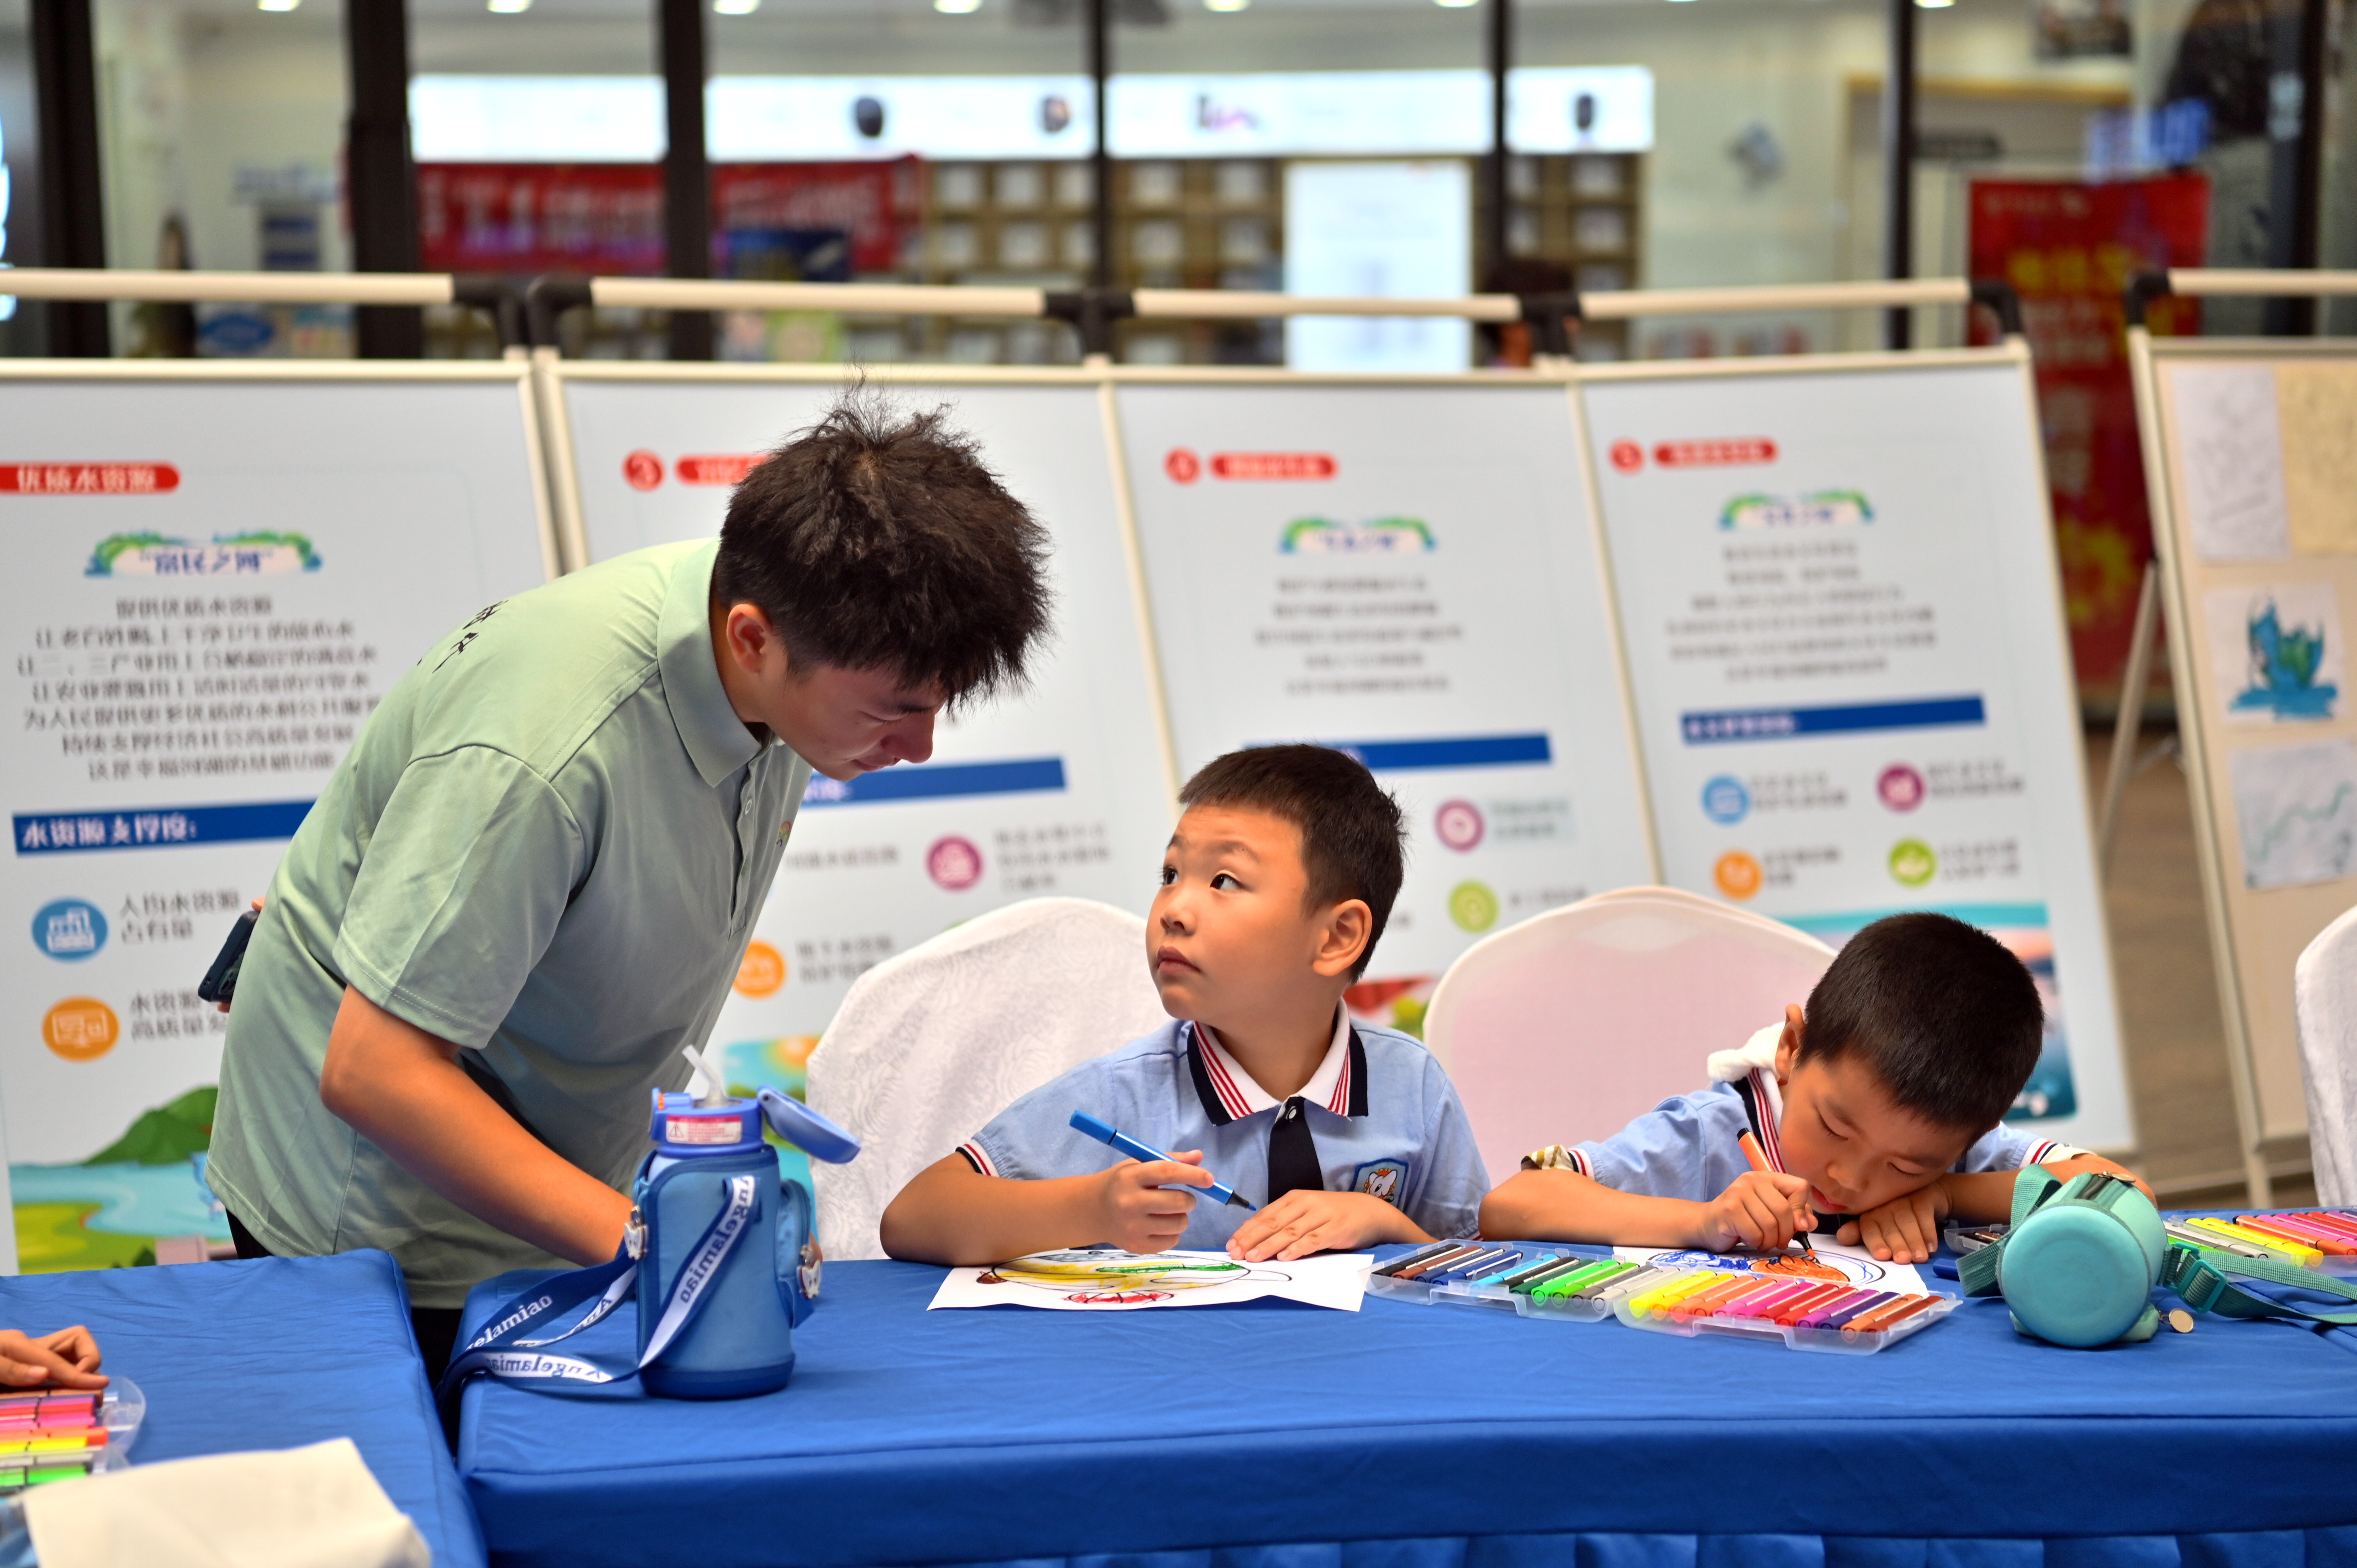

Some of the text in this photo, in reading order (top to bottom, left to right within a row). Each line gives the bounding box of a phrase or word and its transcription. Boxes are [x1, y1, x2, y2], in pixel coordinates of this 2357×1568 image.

[17, 465, 155, 494] 优质水资源
[120, 889, 240, 920] 人均水资源
[121, 917, 194, 945] 占有量
